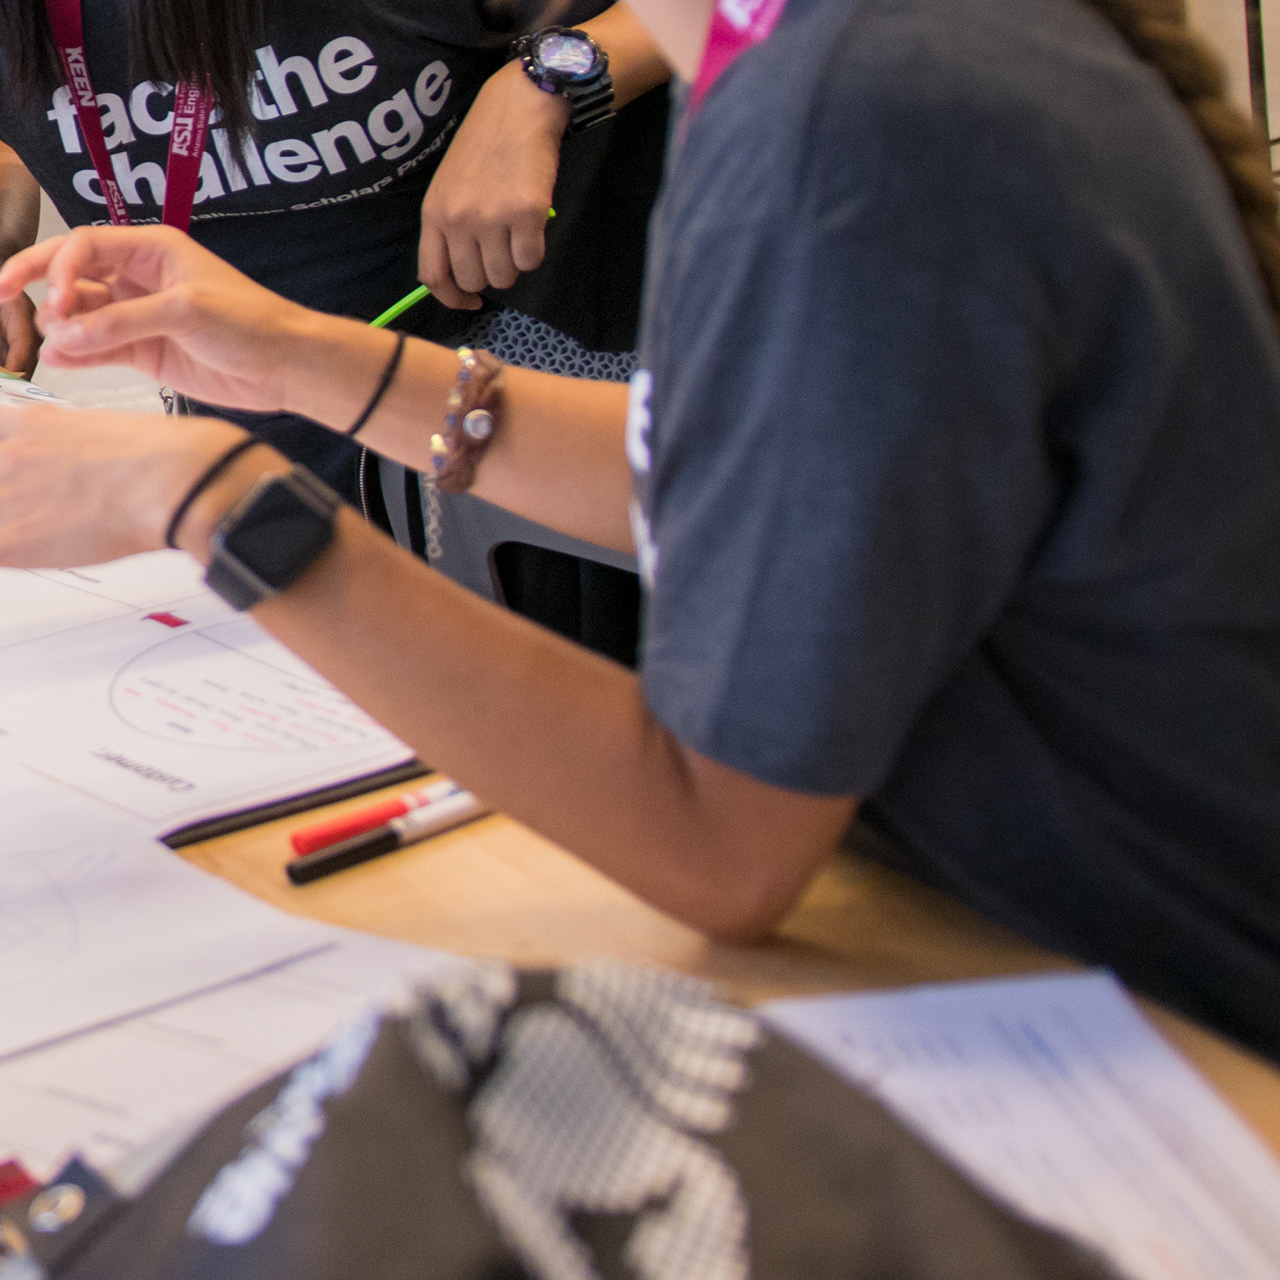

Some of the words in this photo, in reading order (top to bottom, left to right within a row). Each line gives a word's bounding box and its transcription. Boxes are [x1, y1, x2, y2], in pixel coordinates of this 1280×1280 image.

[65, 46, 96, 108] KEEN
[247, 36, 378, 120] the
[171, 117, 193, 157] ASU
[290, 175, 394, 211] Scholars
